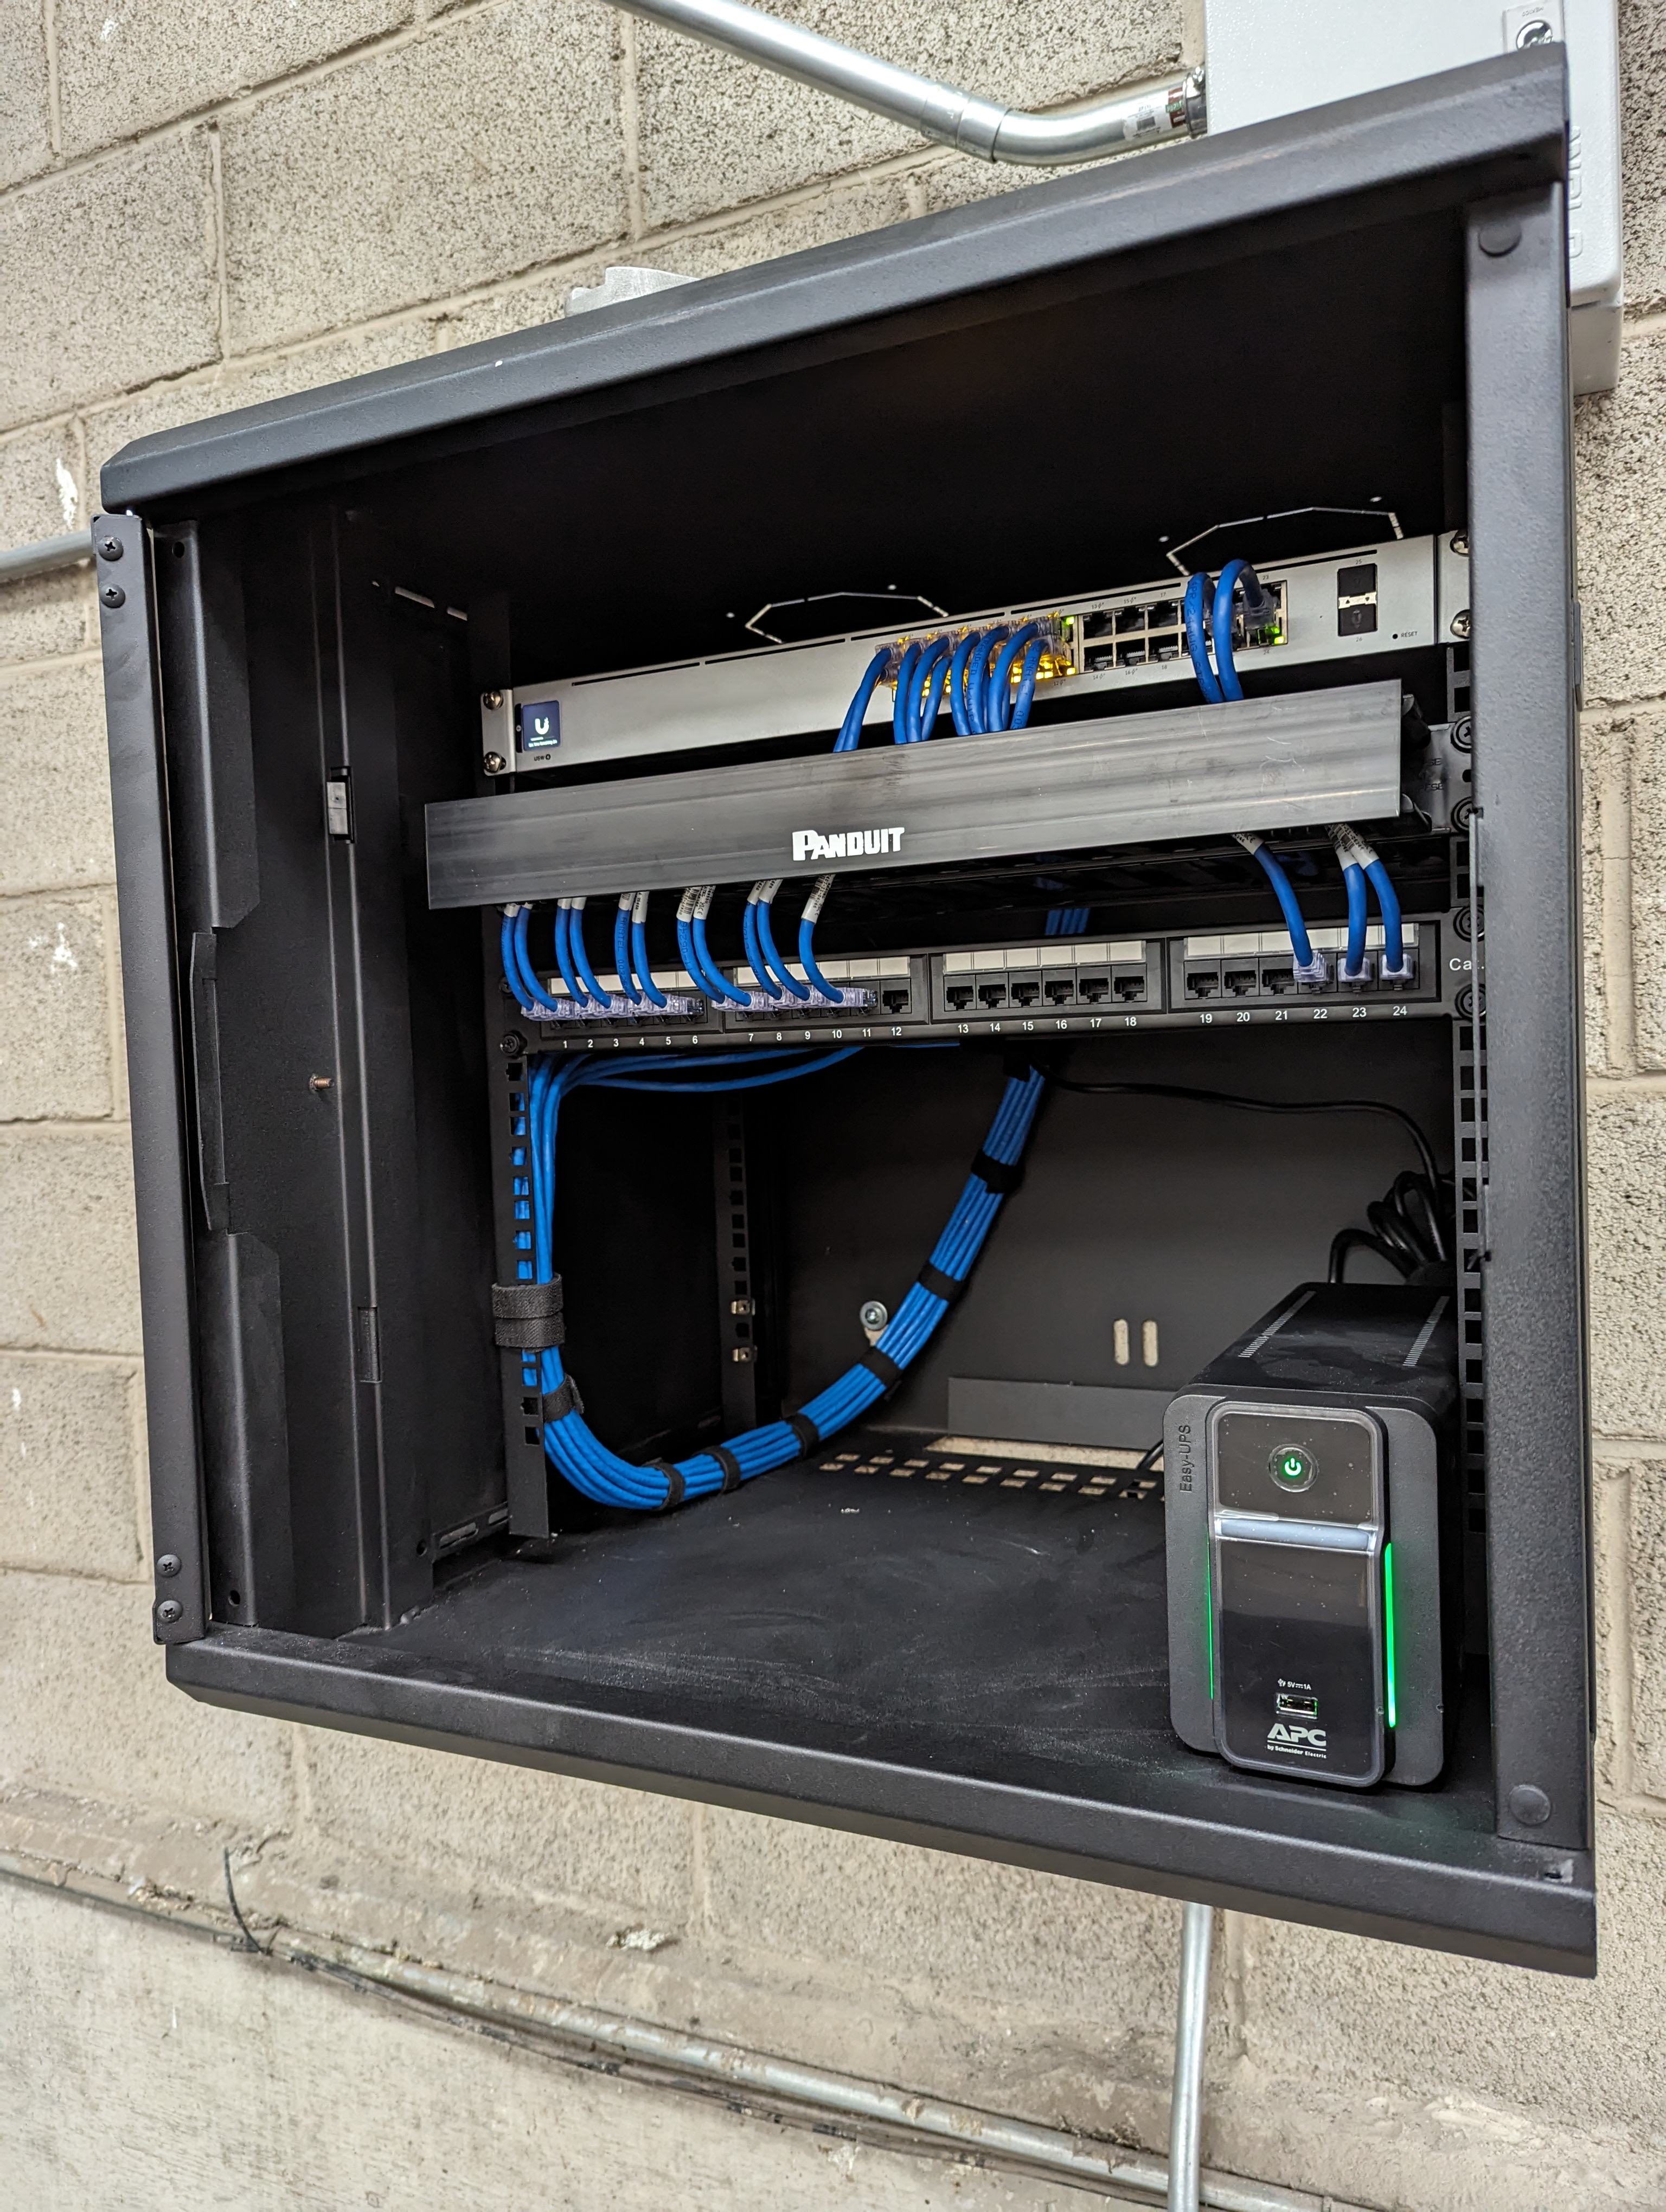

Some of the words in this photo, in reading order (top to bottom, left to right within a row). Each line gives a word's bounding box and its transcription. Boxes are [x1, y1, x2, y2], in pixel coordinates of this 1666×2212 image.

[792, 827, 905, 861] PANDUIT
[618, 916, 628, 953] ANATEL
[563, 1040, 567, 1049] 1
[588, 1039, 593, 1048] 2
[613, 1038, 619, 1047] 3
[639, 1037, 645, 1046] 4
[666, 1037, 671, 1045] 5
[692, 1035, 698, 1044] 6
[748, 1033, 754, 1041] 7
[776, 1032, 782, 1041] 8
[805, 1031, 811, 1040] 9
[832, 1030, 842, 1039] 10
[862, 1028, 871, 1037] 11
[891, 1026, 902, 1036] 12
[958, 1024, 969, 1033] 13
[990, 1023, 1001, 1032] 14
[1022, 1021, 1034, 1031] 15
[1055, 1019, 1067, 1029] 16
[1090, 1018, 1102, 1028] 17
[1124, 1017, 1137, 1026] 18
[1200, 1013, 1213, 1024] 19
[1236, 1012, 1250, 1022] 20
[1275, 1010, 1287, 1020] 21
[1313, 1008, 1328, 1019] 22
[1353, 1007, 1367, 1018] 23
[1393, 1006, 1407, 1016] 24
[1178, 1425, 1195, 1493] Easy-UPS
[1267, 1722, 1327, 1746] APC
[1274, 1745, 1304, 1754] Schneider
[1304, 1751, 1327, 1759] Electric
